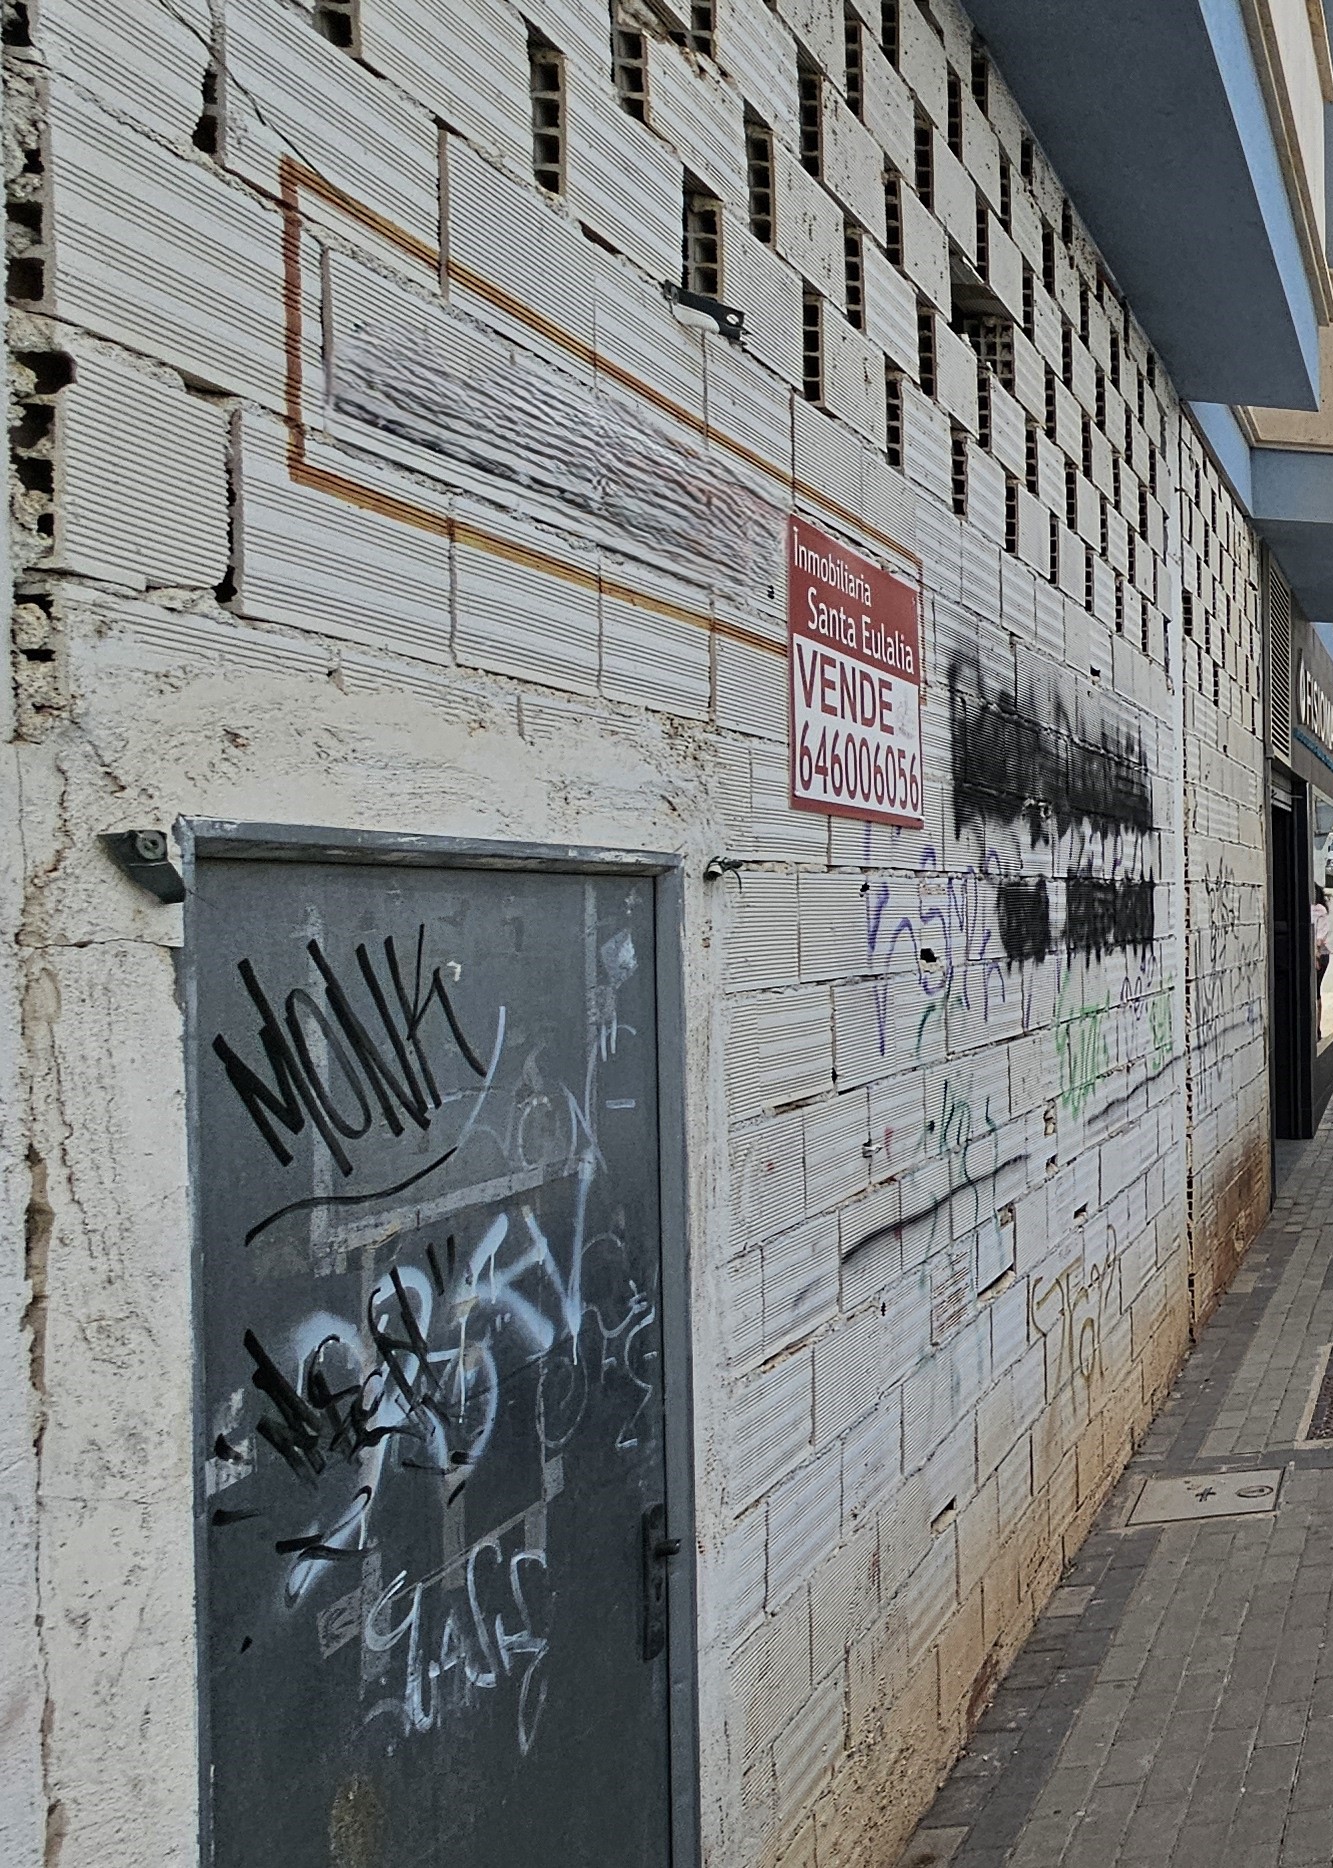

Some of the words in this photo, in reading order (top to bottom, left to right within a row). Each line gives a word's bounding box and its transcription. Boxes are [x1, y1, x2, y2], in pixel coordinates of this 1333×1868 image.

[807, 587, 858, 649] Santa
[862, 617, 915, 675] Eulalia
[796, 642, 895, 736] VENDE
[799, 719, 919, 812] 646006056
